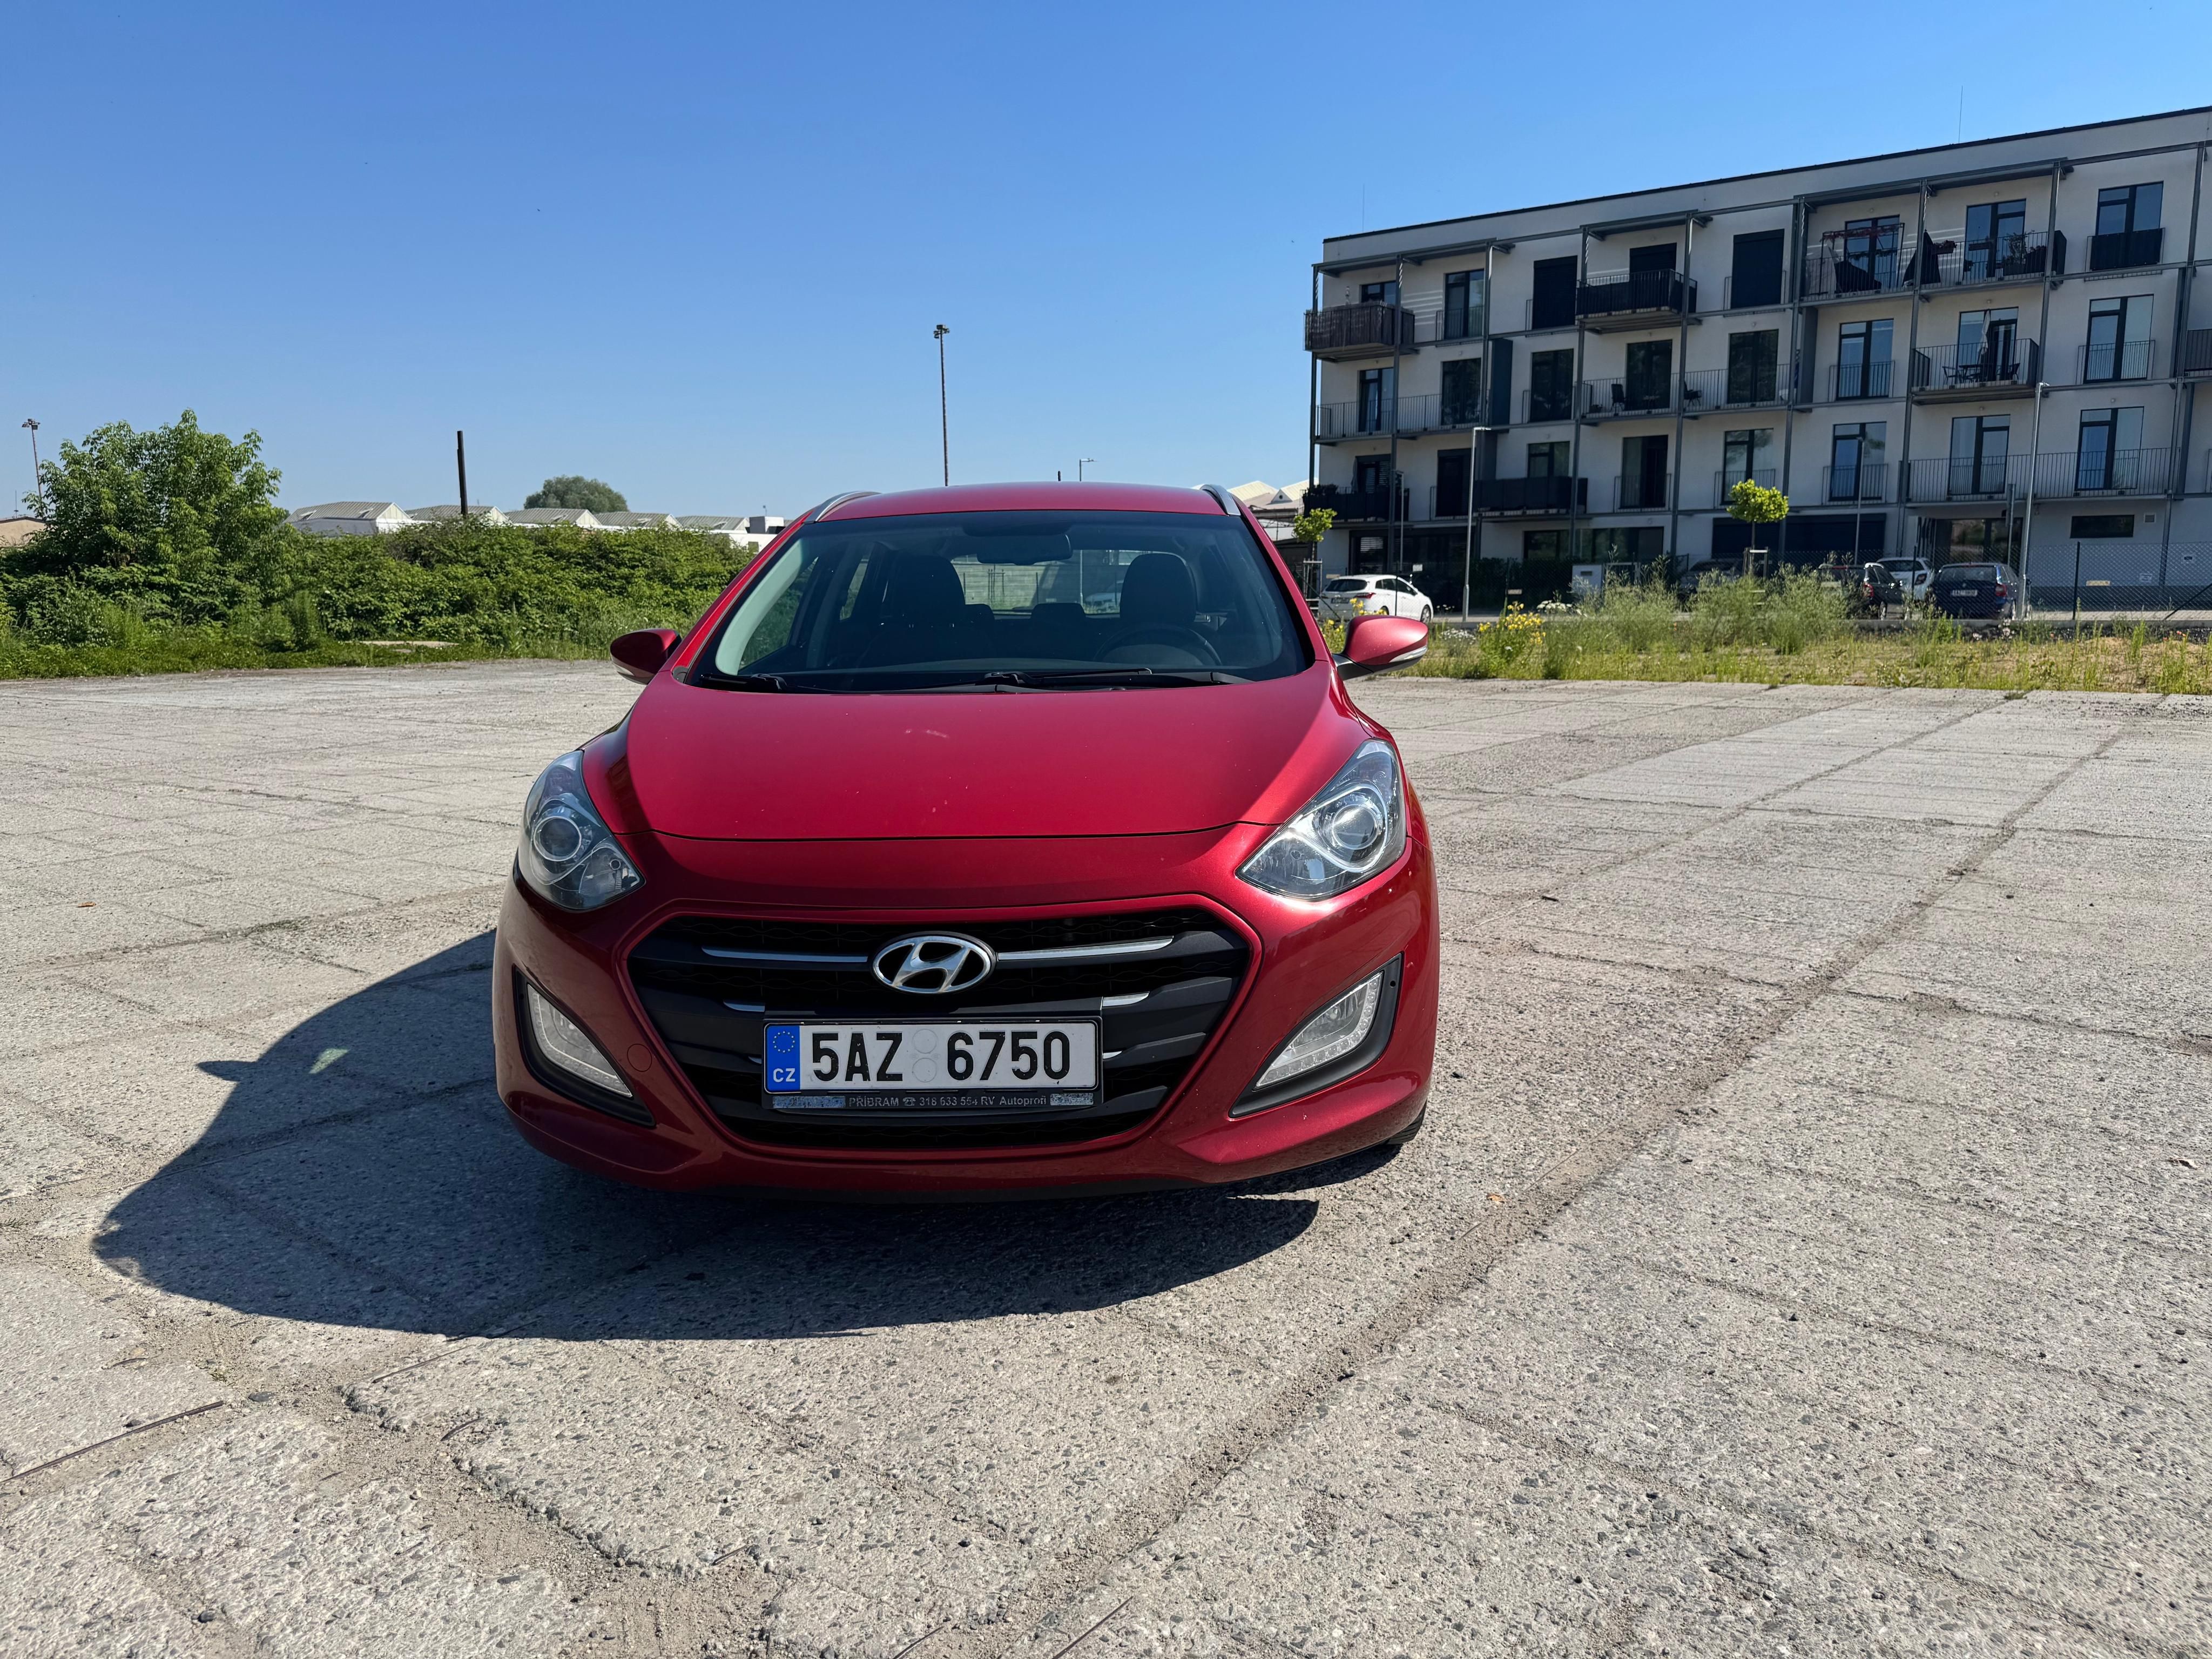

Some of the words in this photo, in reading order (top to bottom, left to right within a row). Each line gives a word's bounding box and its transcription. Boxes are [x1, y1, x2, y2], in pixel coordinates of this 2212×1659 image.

[812, 1032, 903, 1082] 5AZ
[947, 1031, 1070, 1080] 6750
[773, 1068, 795, 1083] CZ
[849, 1096, 899, 1107] PŘÍBRAM
[940, 1097, 957, 1106] 633
[981, 1096, 995, 1105] RV
